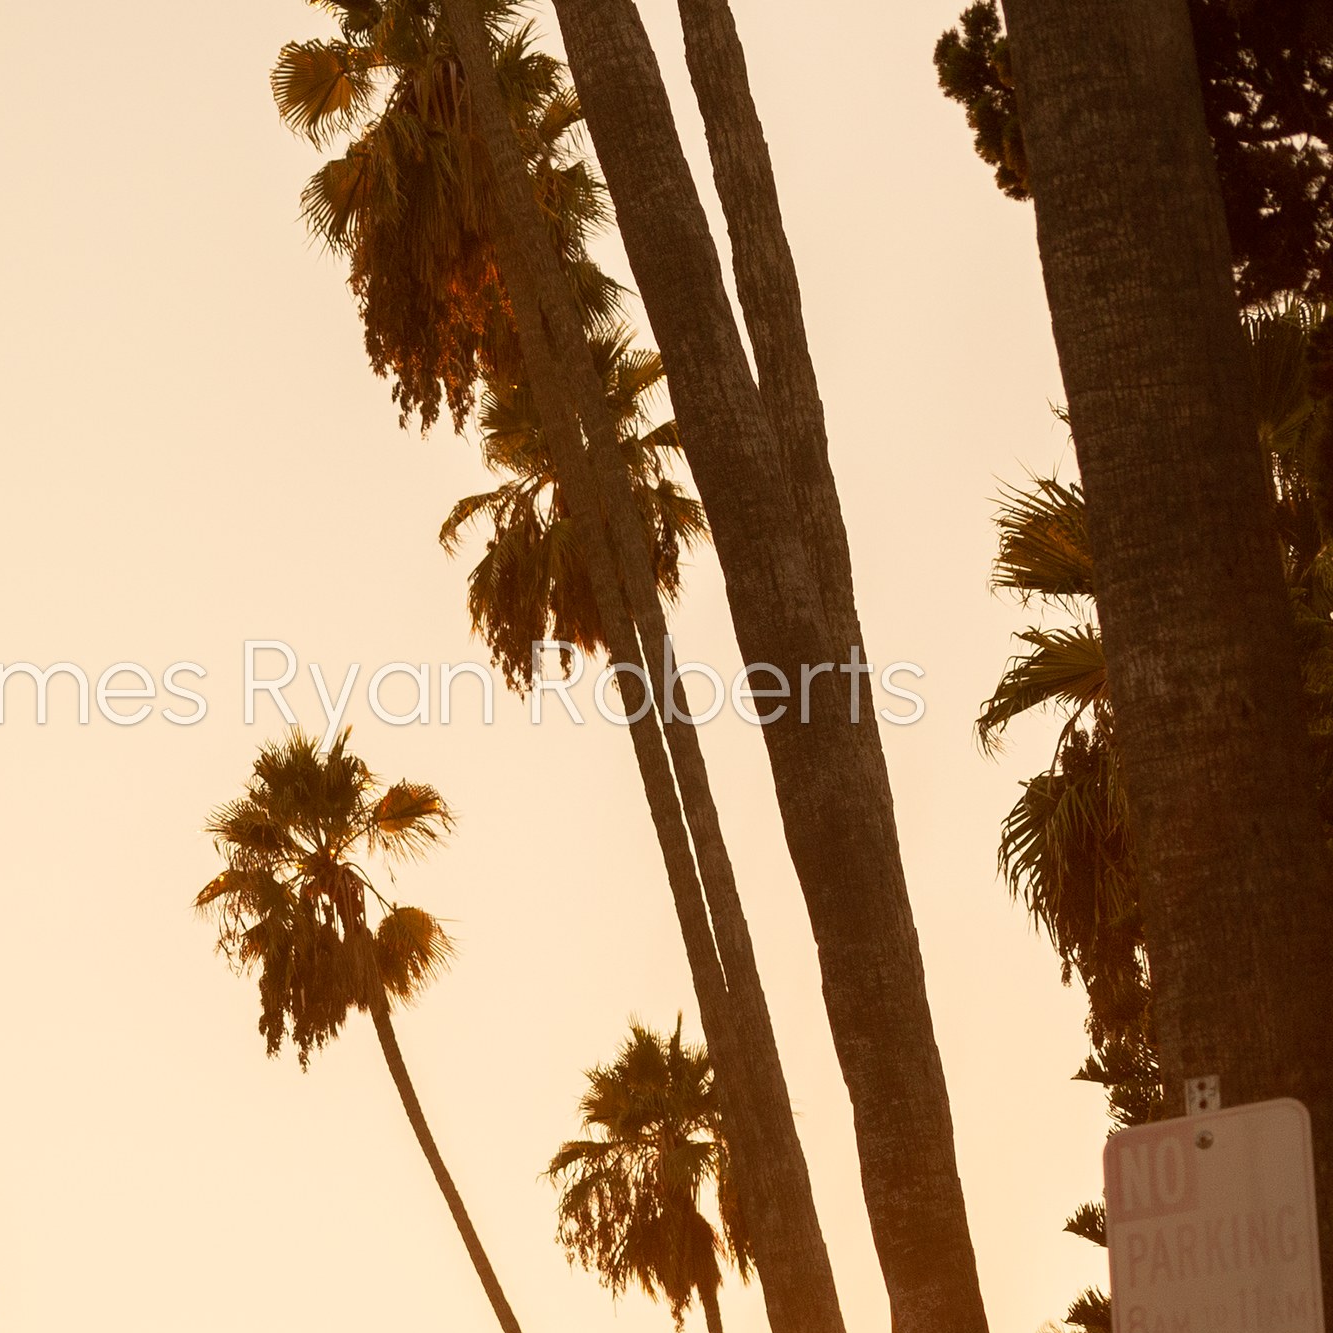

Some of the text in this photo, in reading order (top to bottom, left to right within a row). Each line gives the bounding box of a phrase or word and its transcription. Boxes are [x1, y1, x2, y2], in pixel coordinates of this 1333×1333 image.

[1120, 1136, 1186, 1212] NO
[1126, 1204, 1299, 1289] PARKING
[1203, 1303, 1229, 1329] TO
